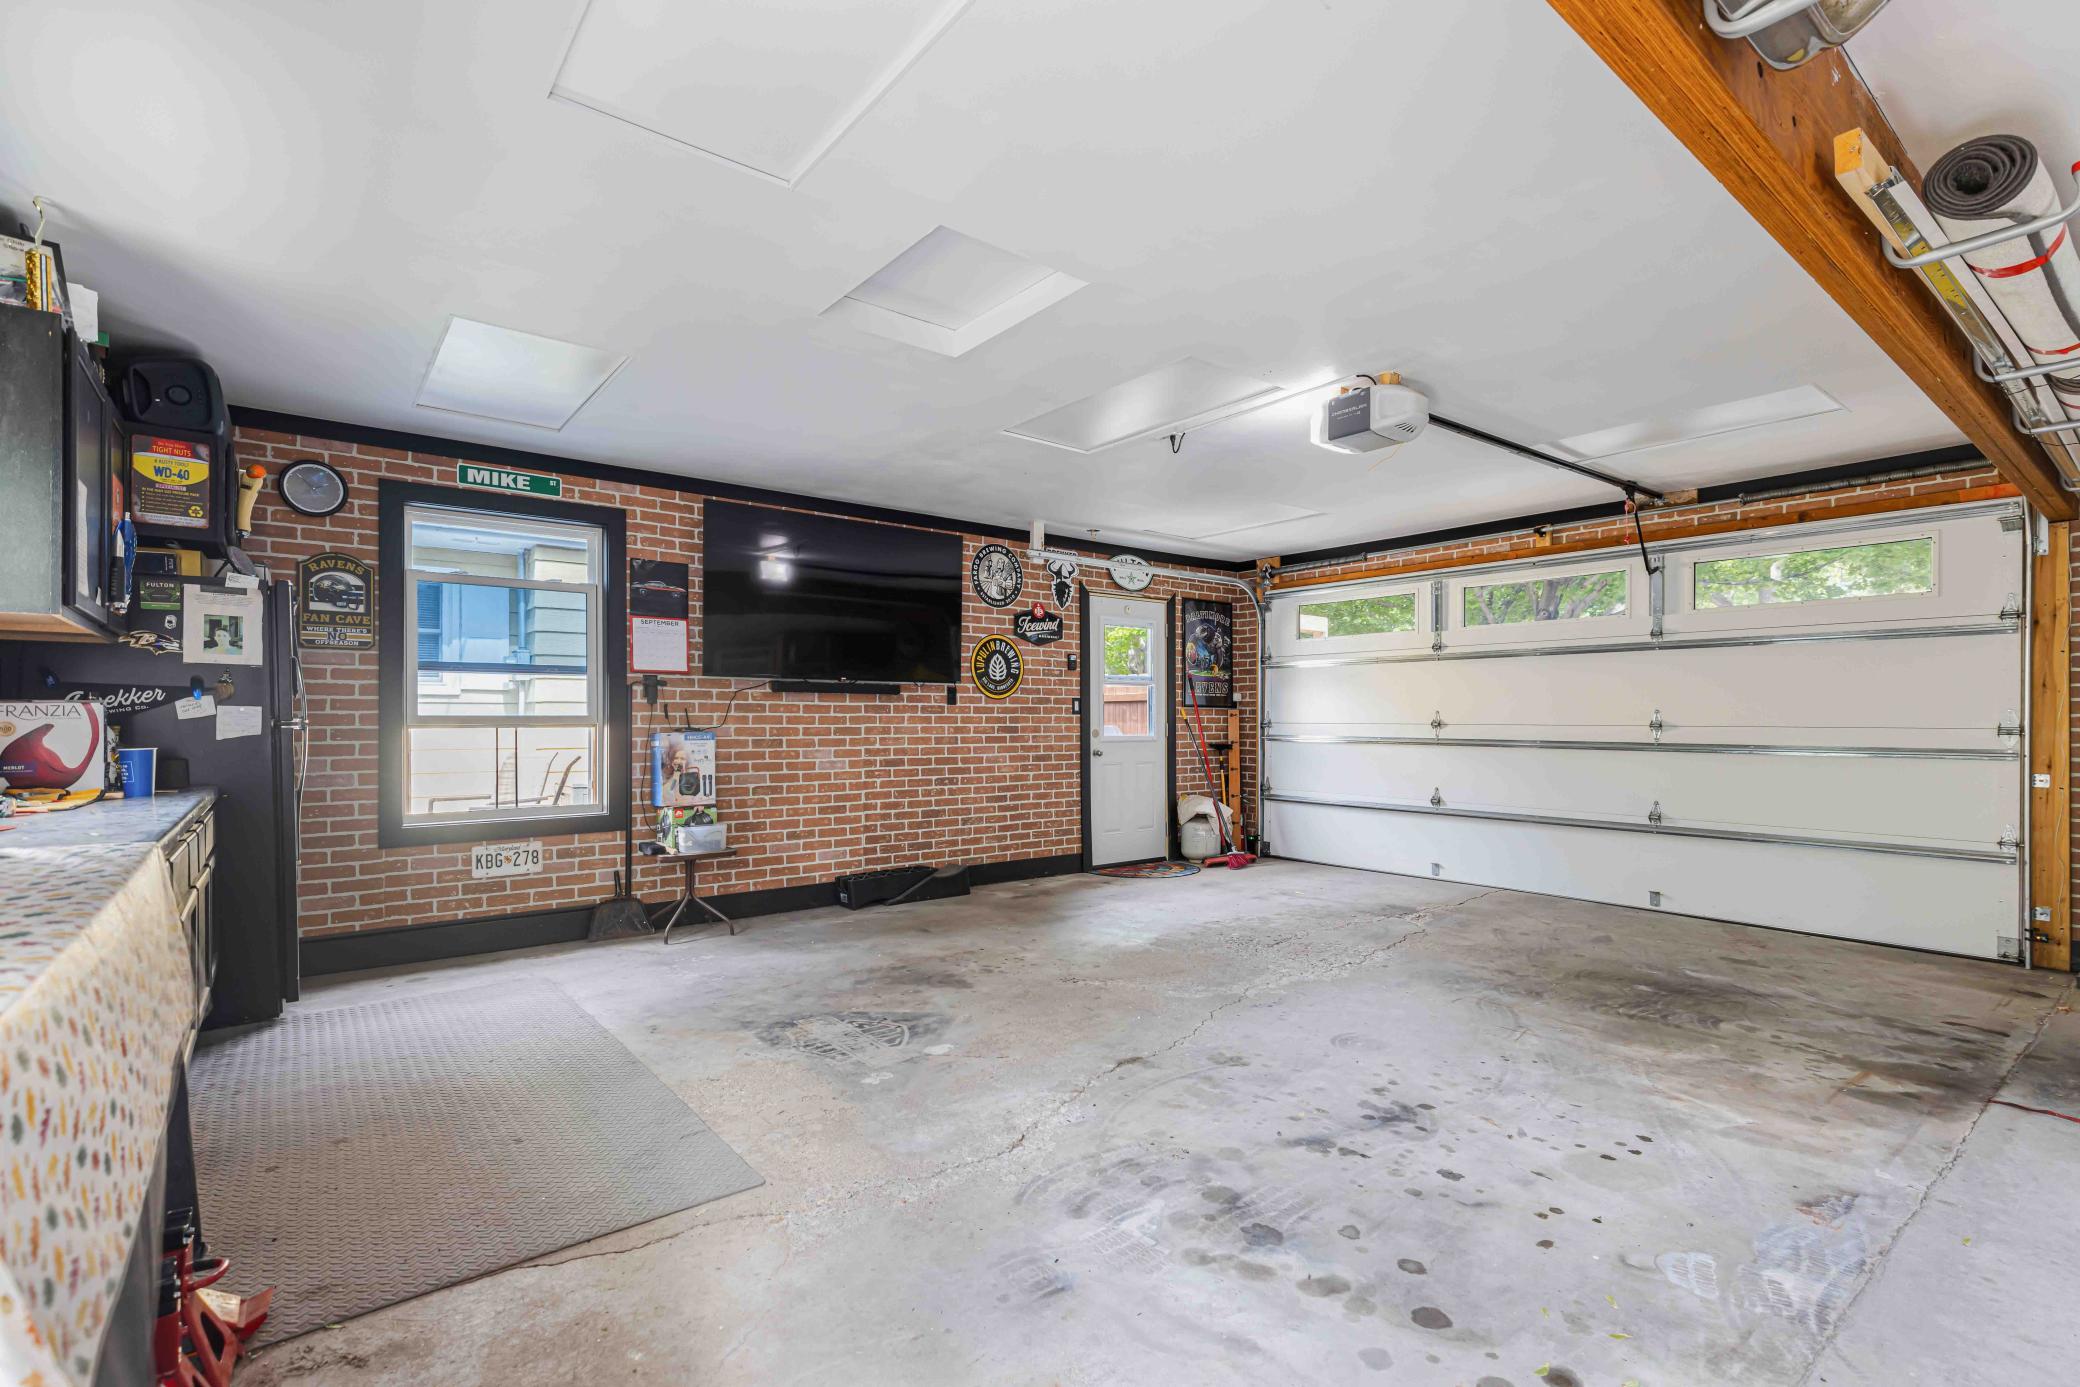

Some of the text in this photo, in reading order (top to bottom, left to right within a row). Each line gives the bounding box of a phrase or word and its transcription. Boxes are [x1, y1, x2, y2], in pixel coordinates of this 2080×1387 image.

[152, 445, 191, 457] TIGHT NUTS
[153, 465, 190, 480] WD-40
[467, 468, 531, 491] MIKE
[307, 560, 366, 575] RAVENS
[972, 546, 1022, 589] FARGO BREWING COMPANY
[303, 613, 371, 625] FAN CAVE
[640, 619, 679, 627] SEPTEMBER
[1017, 616, 1060, 633] Icewind
[976, 640, 1020, 674] LUPULIN BREWING
[475, 850, 539, 870] KBG 278
